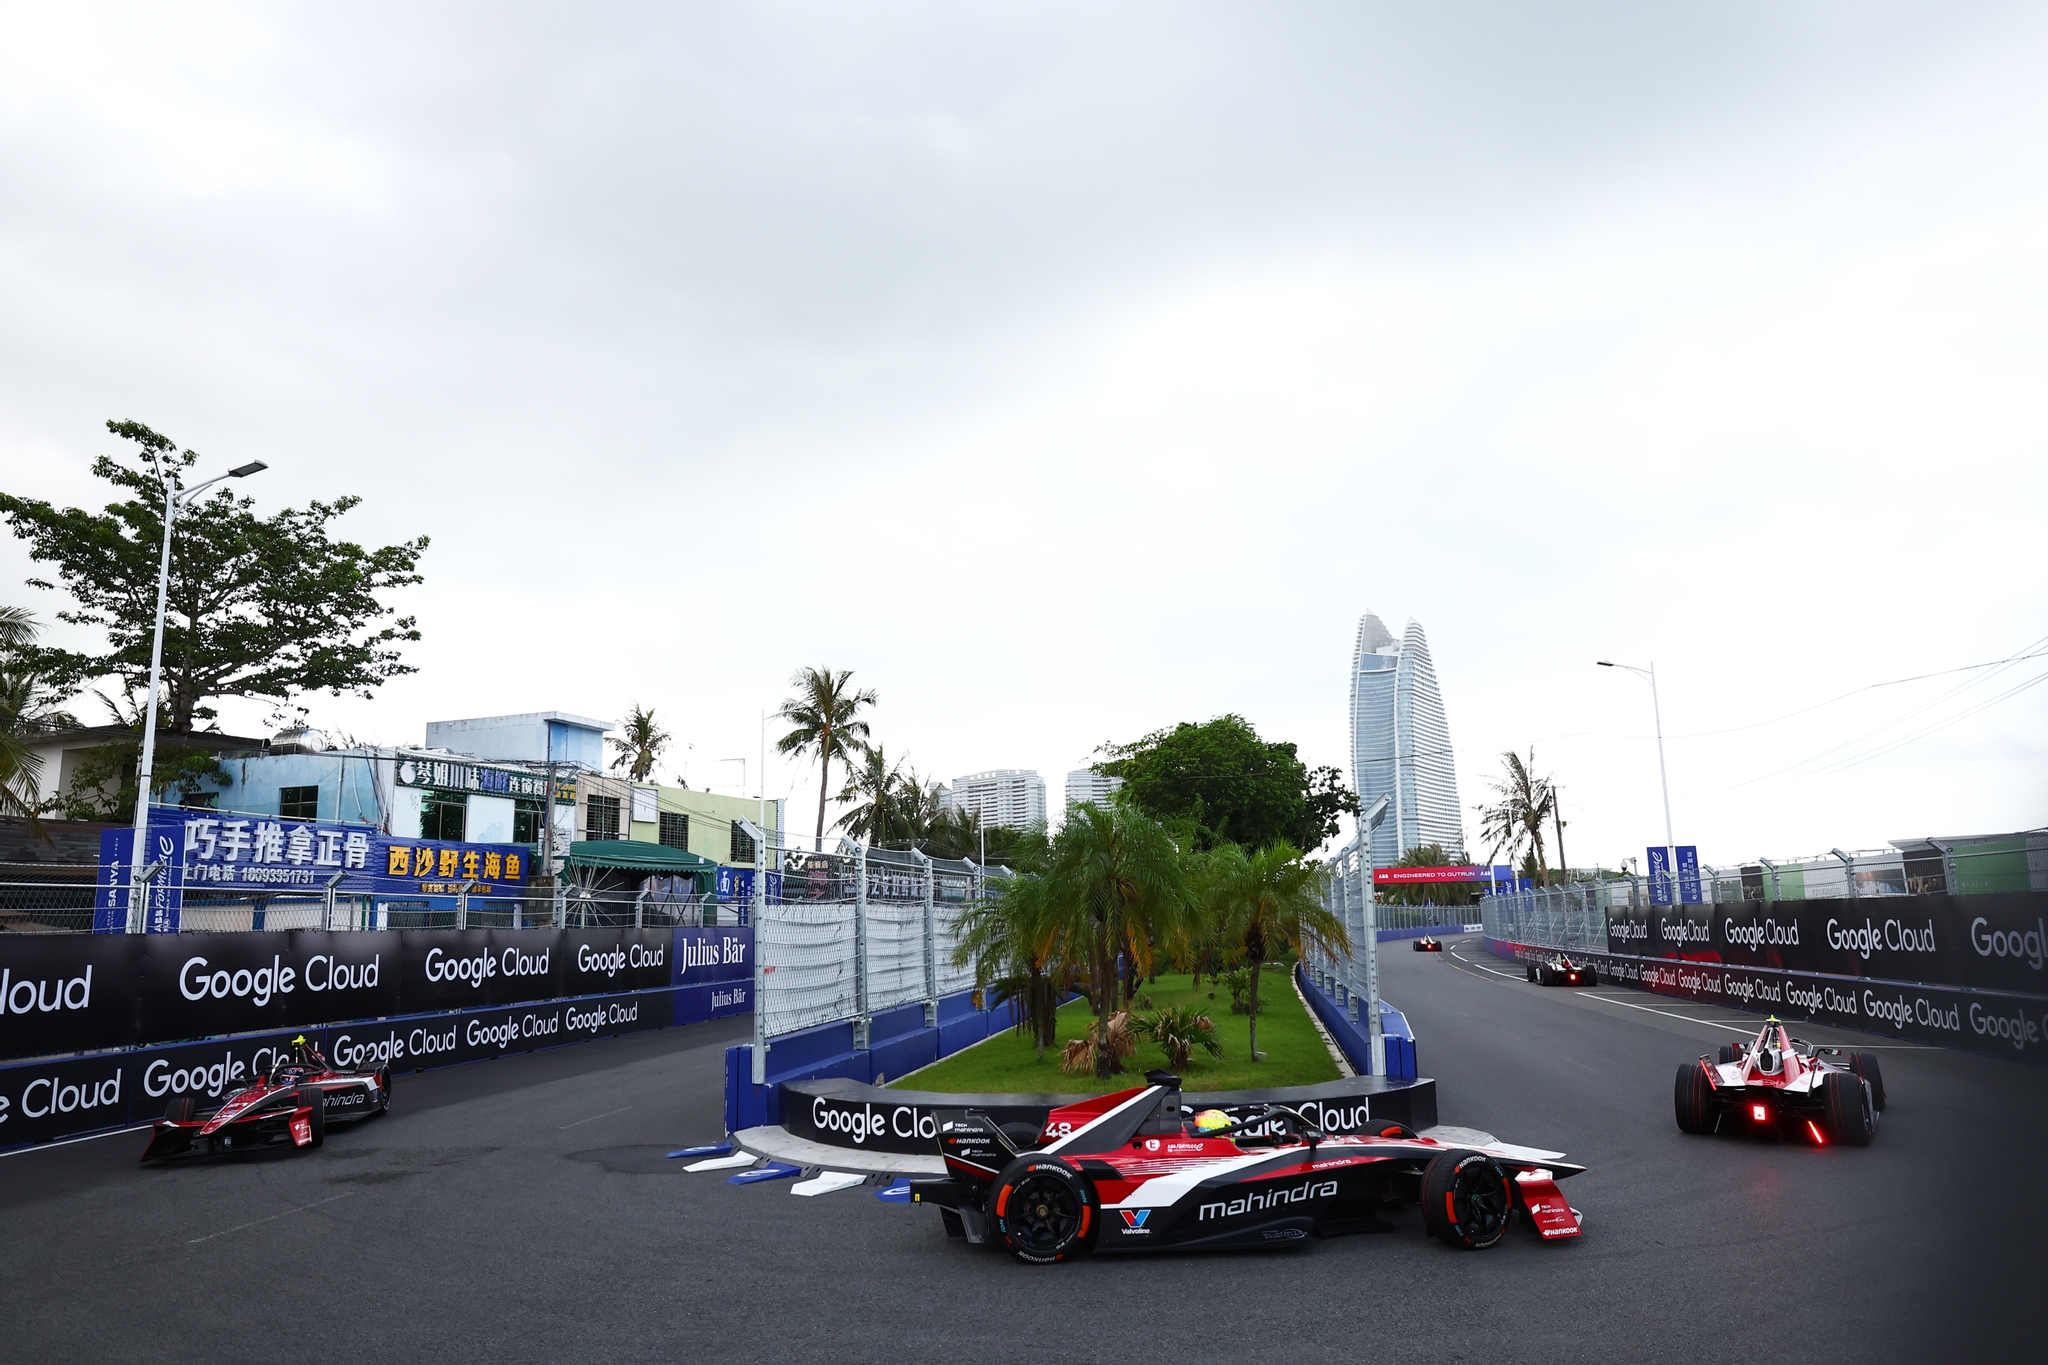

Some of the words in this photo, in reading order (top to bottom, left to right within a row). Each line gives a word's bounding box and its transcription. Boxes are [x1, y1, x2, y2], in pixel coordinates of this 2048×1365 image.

[415, 761, 549, 797] 琴姐川味海鲜连锁餐
[185, 818, 370, 869] 巧手推拿正骨
[154, 853, 169, 909] FORMUA
[388, 845, 521, 880] 西沙野生海鱼
[108, 860, 120, 907] SANYA
[154, 909, 164, 932] ABB
[1608, 917, 1630, 944] Google
[1629, 919, 1648, 940] Cloud
[1660, 917, 1688, 948] Google
[1687, 919, 1710, 942] Cloud
[1725, 917, 1765, 951] Google
[1765, 918, 1800, 946] Cloud
[1826, 918, 1883, 960] Google
[1884, 918, 1936, 952] Cloud
[577, 944, 626, 978] Google
[629, 943, 664, 968] Cloud
[681, 937, 720, 974] Julius
[722, 936, 746, 964] Bär
[1970, 916, 2048, 970] Googl
[179, 954, 296, 1007] Google
[305, 953, 380, 992] Cloud
[425, 948, 497, 988] Google
[502, 947, 549, 977] Cloud
[1608, 960, 1625, 981] Google
[1624, 962, 1639, 980] Cloud
[1639, 964, 1659, 988] Google
[1659, 967, 1676, 986] Cloud
[1678, 968, 1701, 994] Google
[1702, 972, 1721, 993] Cloud
[0, 965, 93, 1015] loud
[711, 990, 732, 1012] Julius
[733, 988, 746, 1006] Bär
[1724, 973, 1754, 1003] Google
[1755, 978, 1781, 1002] Cloud
[1786, 980, 1823, 1014] Google
[1824, 986, 1858, 1015] Cloud
[565, 1005, 607, 1034] Google
[608, 1001, 638, 1025] Cloud
[1863, 989, 1913, 1030] Google
[1915, 997, 1961, 1032] Cloud
[1969, 1002, 2040, 1050] Google
[333, 1030, 404, 1067] Google
[409, 1025, 457, 1056] Cloud
[466, 1019, 519, 1049] Google
[522, 1011, 559, 1039] Cloud
[143, 1051, 245, 1098] Google
[252, 1041, 319, 1077] Clo
[22, 1068, 122, 1118] Cloud
[812, 1096, 886, 1144] Google
[892, 1106, 936, 1139] Clo
[1045, 1122, 1072, 1138] 48
[1298, 1097, 1370, 1132] Cloud
[1311, 1159, 1352, 1170] mahindra
[1199, 1180, 1338, 1221] mahindra
